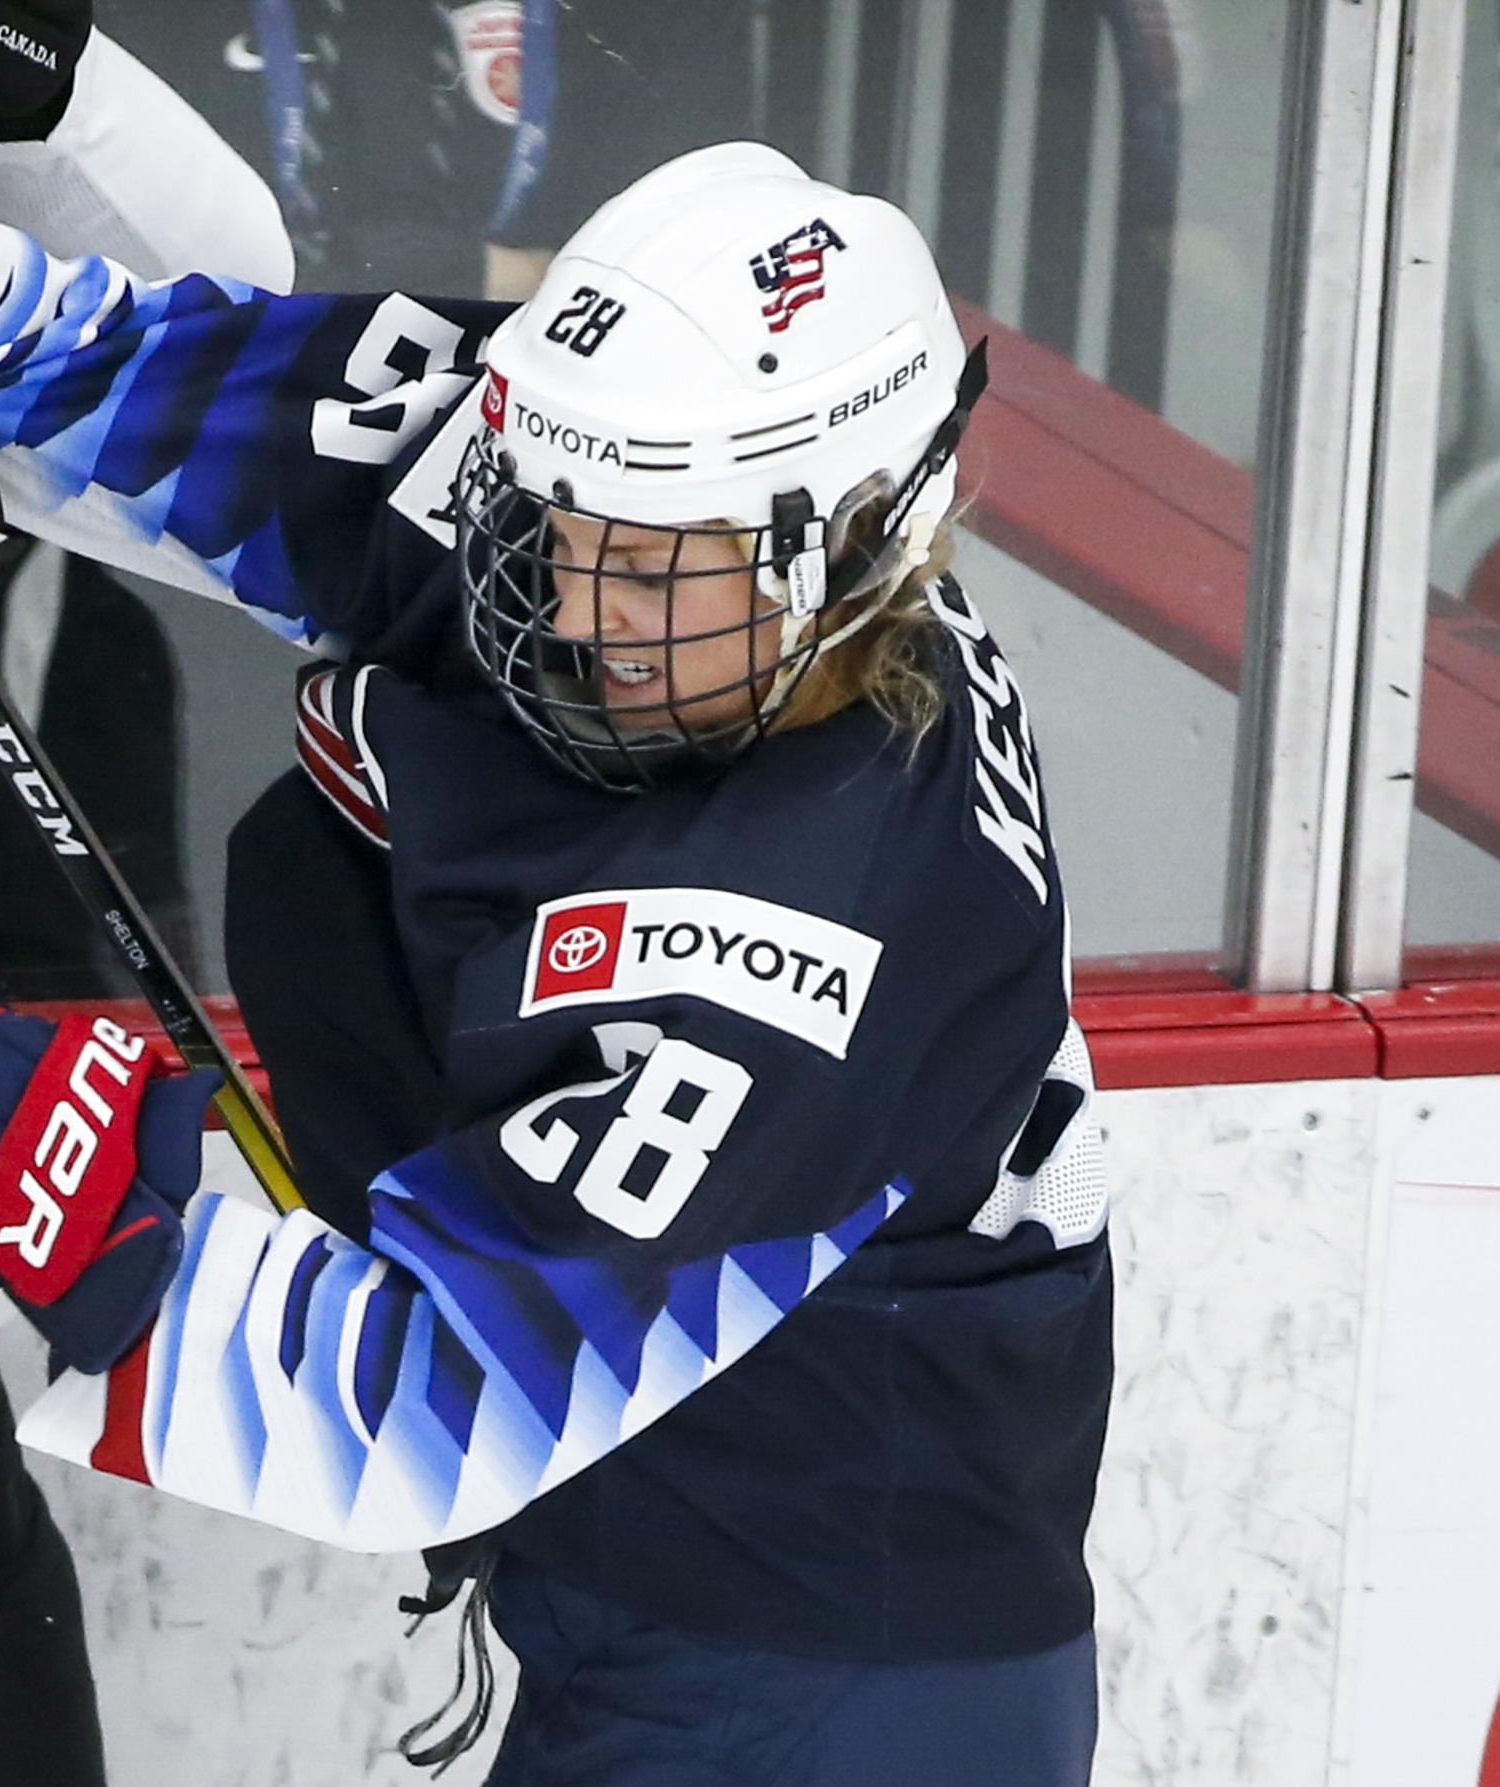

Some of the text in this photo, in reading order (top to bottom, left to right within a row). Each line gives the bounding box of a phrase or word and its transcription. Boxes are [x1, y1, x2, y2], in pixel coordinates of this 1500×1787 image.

[544, 285, 627, 358] 28
[828, 350, 929, 428] BAUER
[514, 402, 622, 467] TOYOTA
[104, 909, 150, 971] SHELTON
[631, 922, 851, 1017] TOYOTA
[499, 1021, 755, 1240] 28
